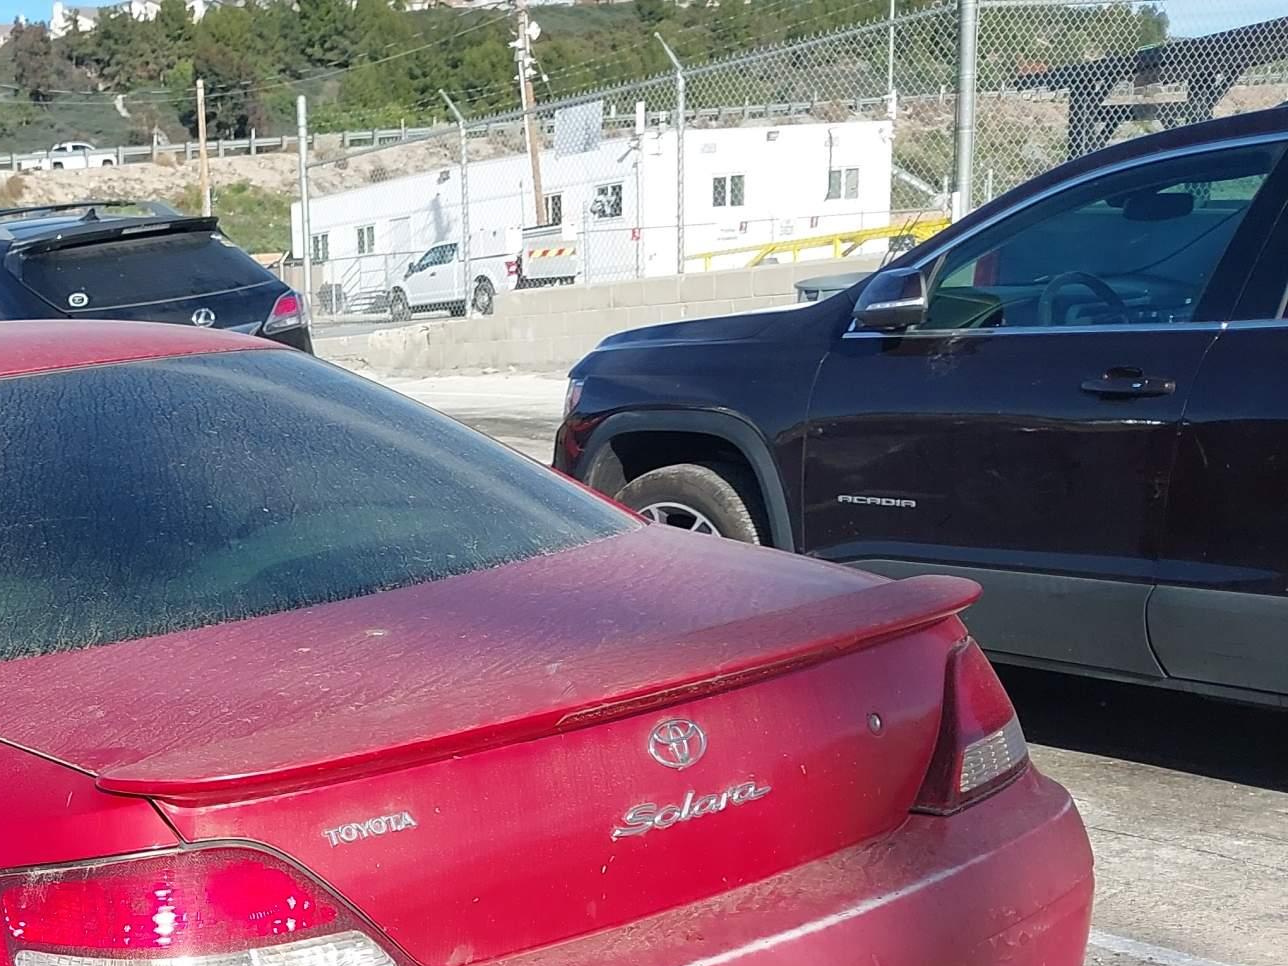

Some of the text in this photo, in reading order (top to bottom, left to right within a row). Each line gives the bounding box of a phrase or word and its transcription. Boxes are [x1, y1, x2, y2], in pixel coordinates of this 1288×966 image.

[837, 494, 917, 508] ACADIA
[324, 810, 417, 848] TOYOTA
[611, 782, 771, 838] Solara
